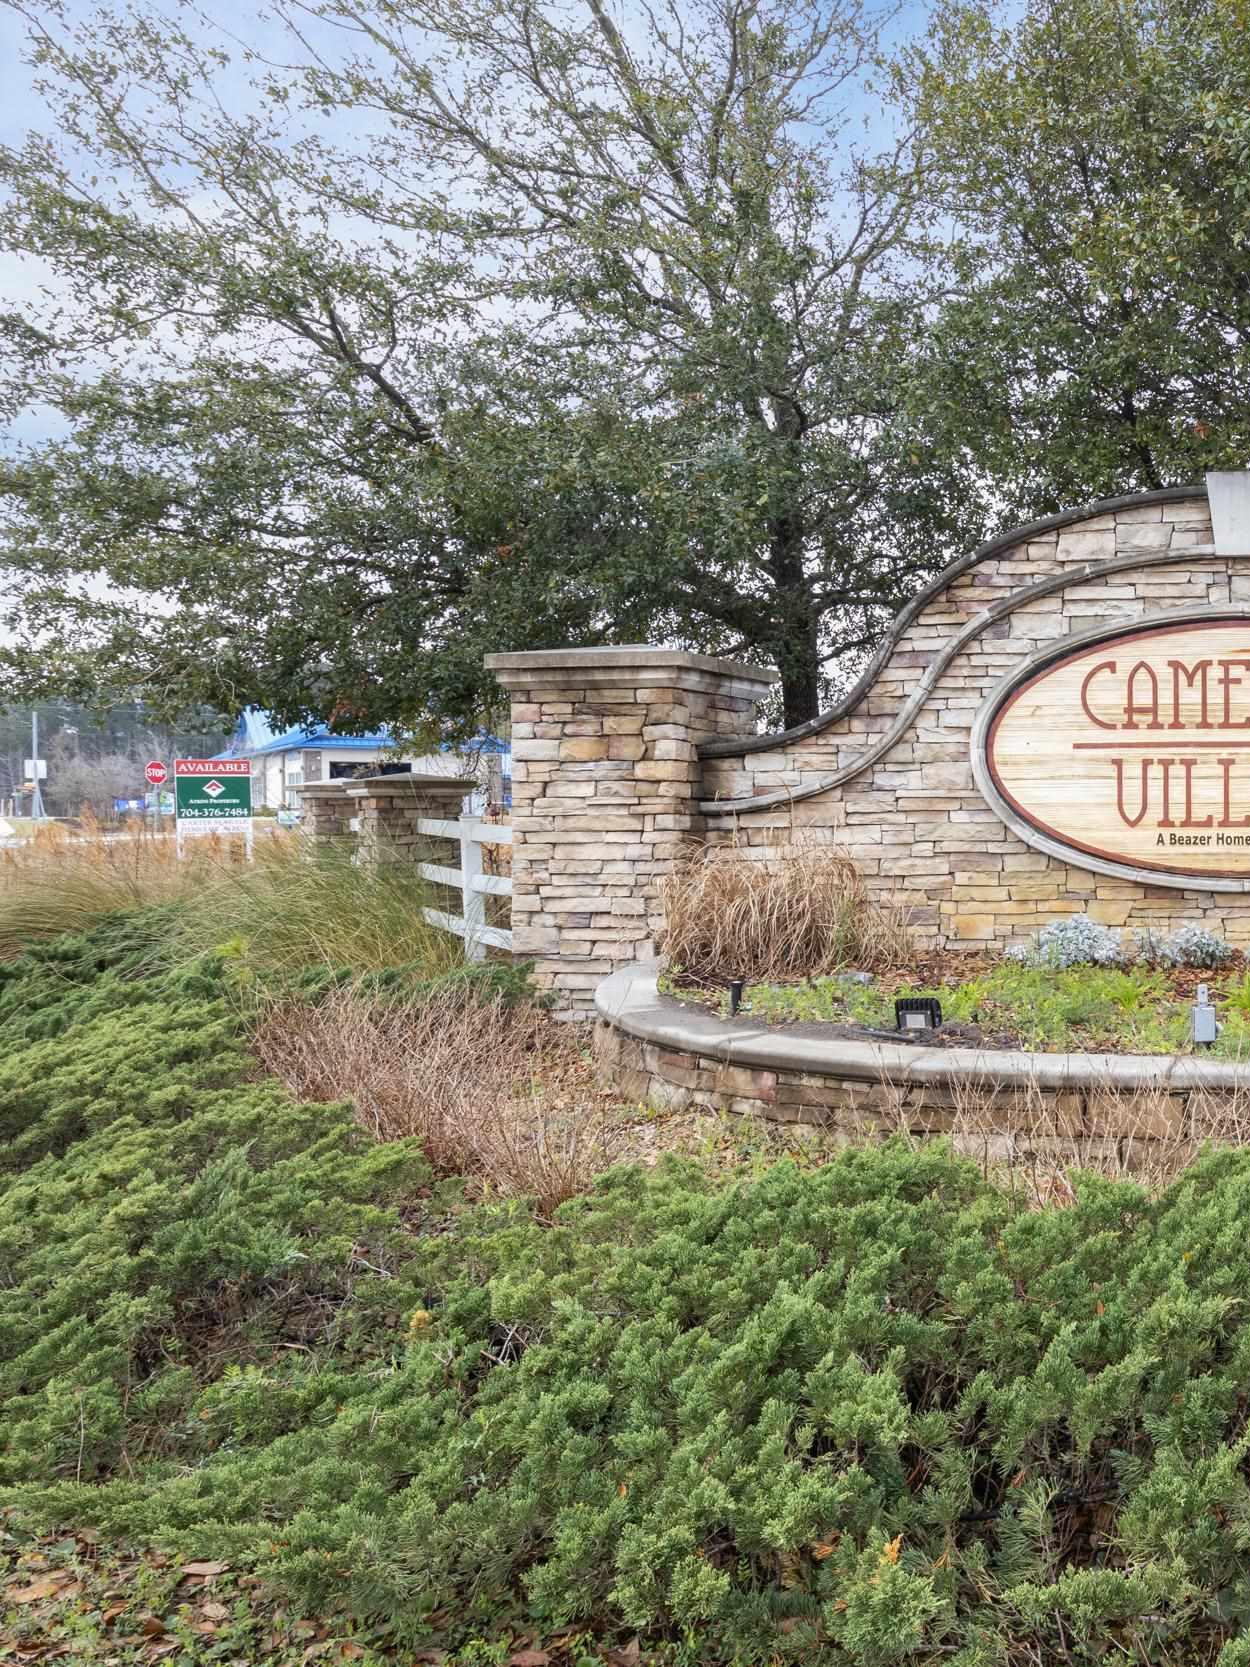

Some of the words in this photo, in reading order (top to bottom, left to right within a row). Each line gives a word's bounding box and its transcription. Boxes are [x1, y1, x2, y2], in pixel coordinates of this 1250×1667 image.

[178, 763, 249, 772] AVAILABLE
[147, 768, 166, 778] STOP
[180, 807, 249, 817] 704-376-7484
[1156, 832, 1165, 845] A
[1169, 832, 1212, 846] Beazer
